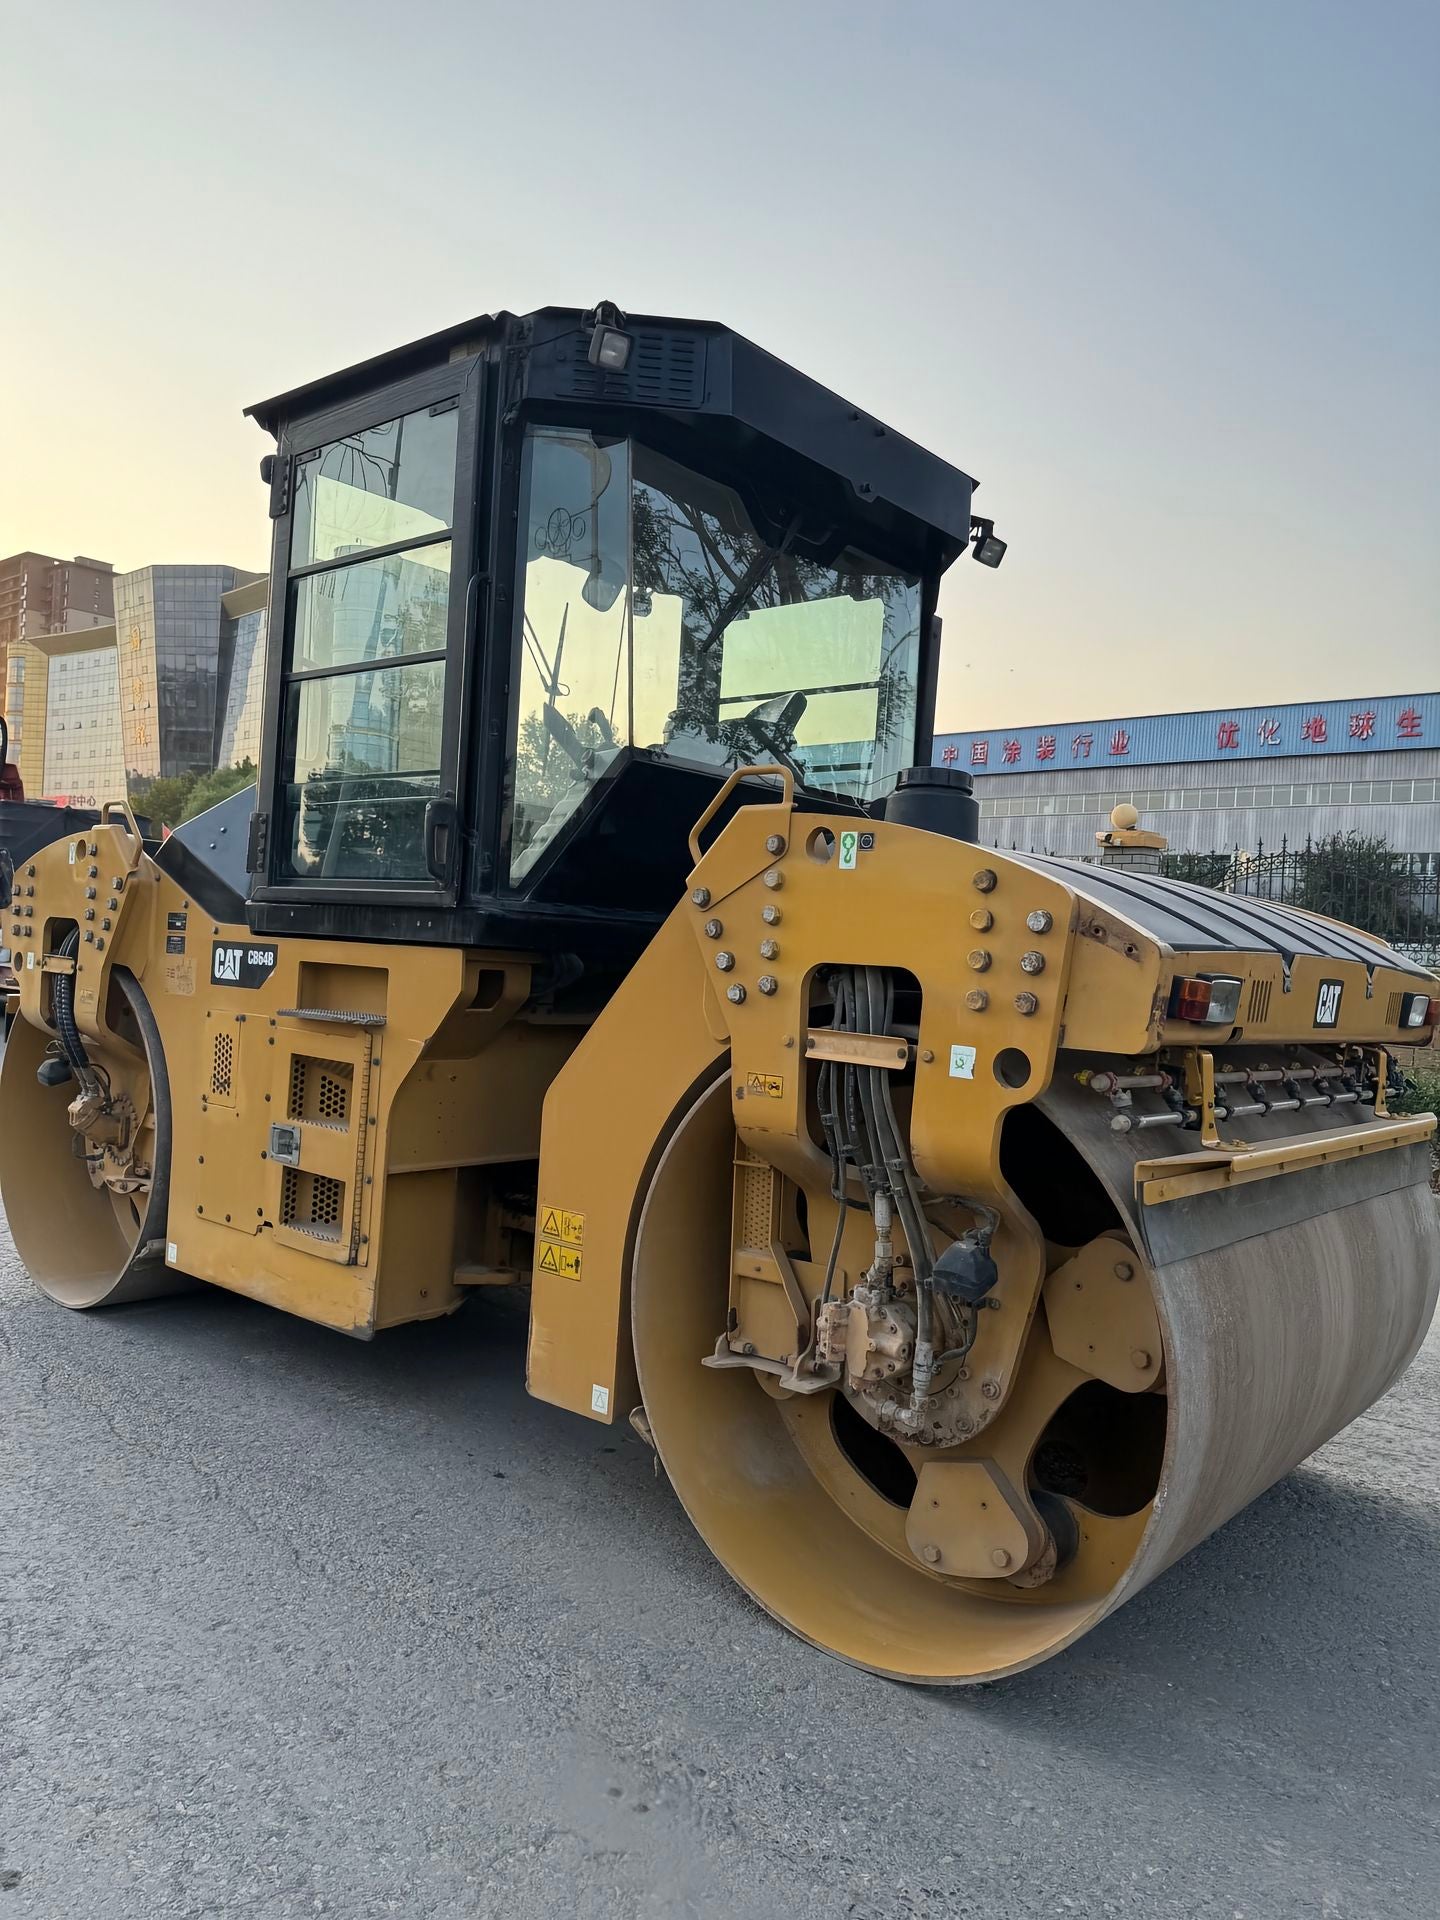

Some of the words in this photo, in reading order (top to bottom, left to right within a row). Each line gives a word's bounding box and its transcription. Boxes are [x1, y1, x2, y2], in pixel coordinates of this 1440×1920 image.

[942, 729, 1130, 766] 中国涂装行业
[1217, 707, 1423, 749] 优化地球生
[214, 947, 243, 980] CAT
[247, 950, 274, 966] CB64B
[1316, 983, 1342, 1023] CAT
